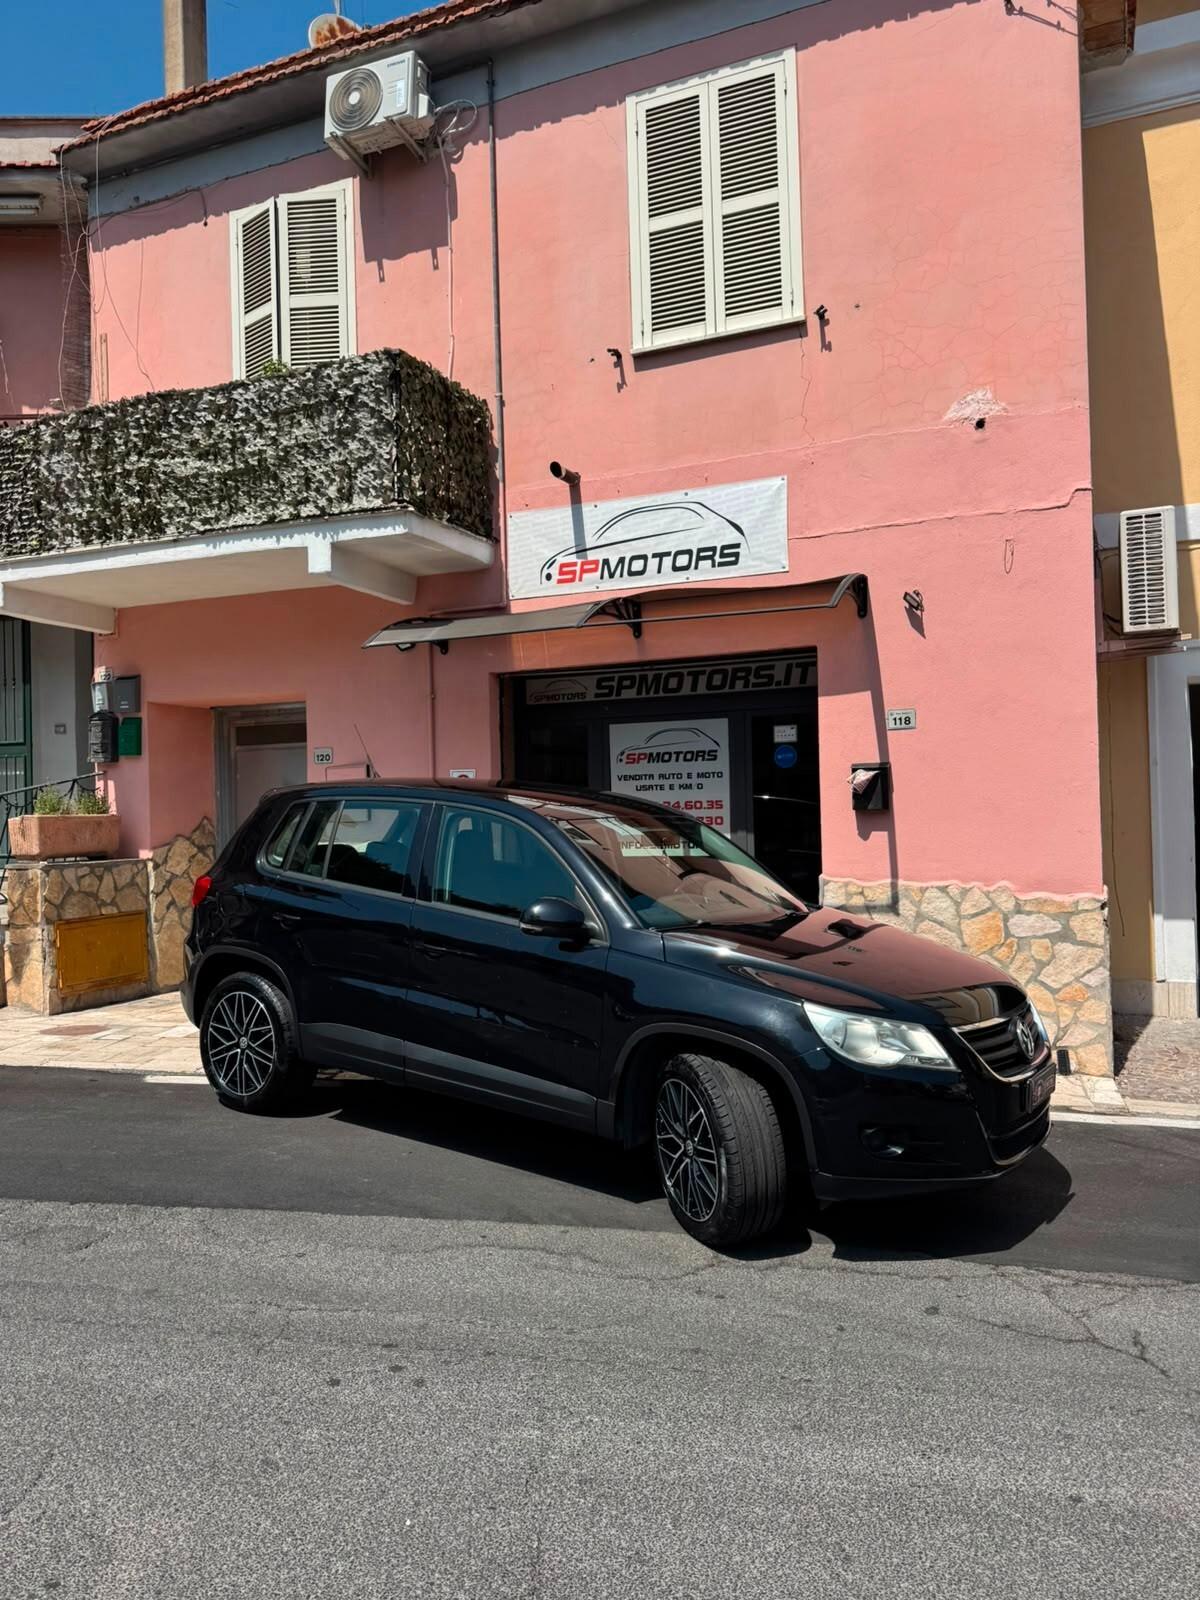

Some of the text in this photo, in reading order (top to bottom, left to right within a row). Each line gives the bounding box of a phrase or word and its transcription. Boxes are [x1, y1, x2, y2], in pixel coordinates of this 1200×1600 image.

[556, 542, 742, 584] SPMOTORS
[593, 661, 816, 699] SPMOTORS.IT
[892, 715, 911, 726] 118
[316, 753, 331, 762] 120
[625, 749, 718, 765] SPMOTORS
[617, 771, 724, 782] VENDITA AUTO E MOTO
[635, 784, 665, 792] USATE
[669, 783, 675, 791] E
